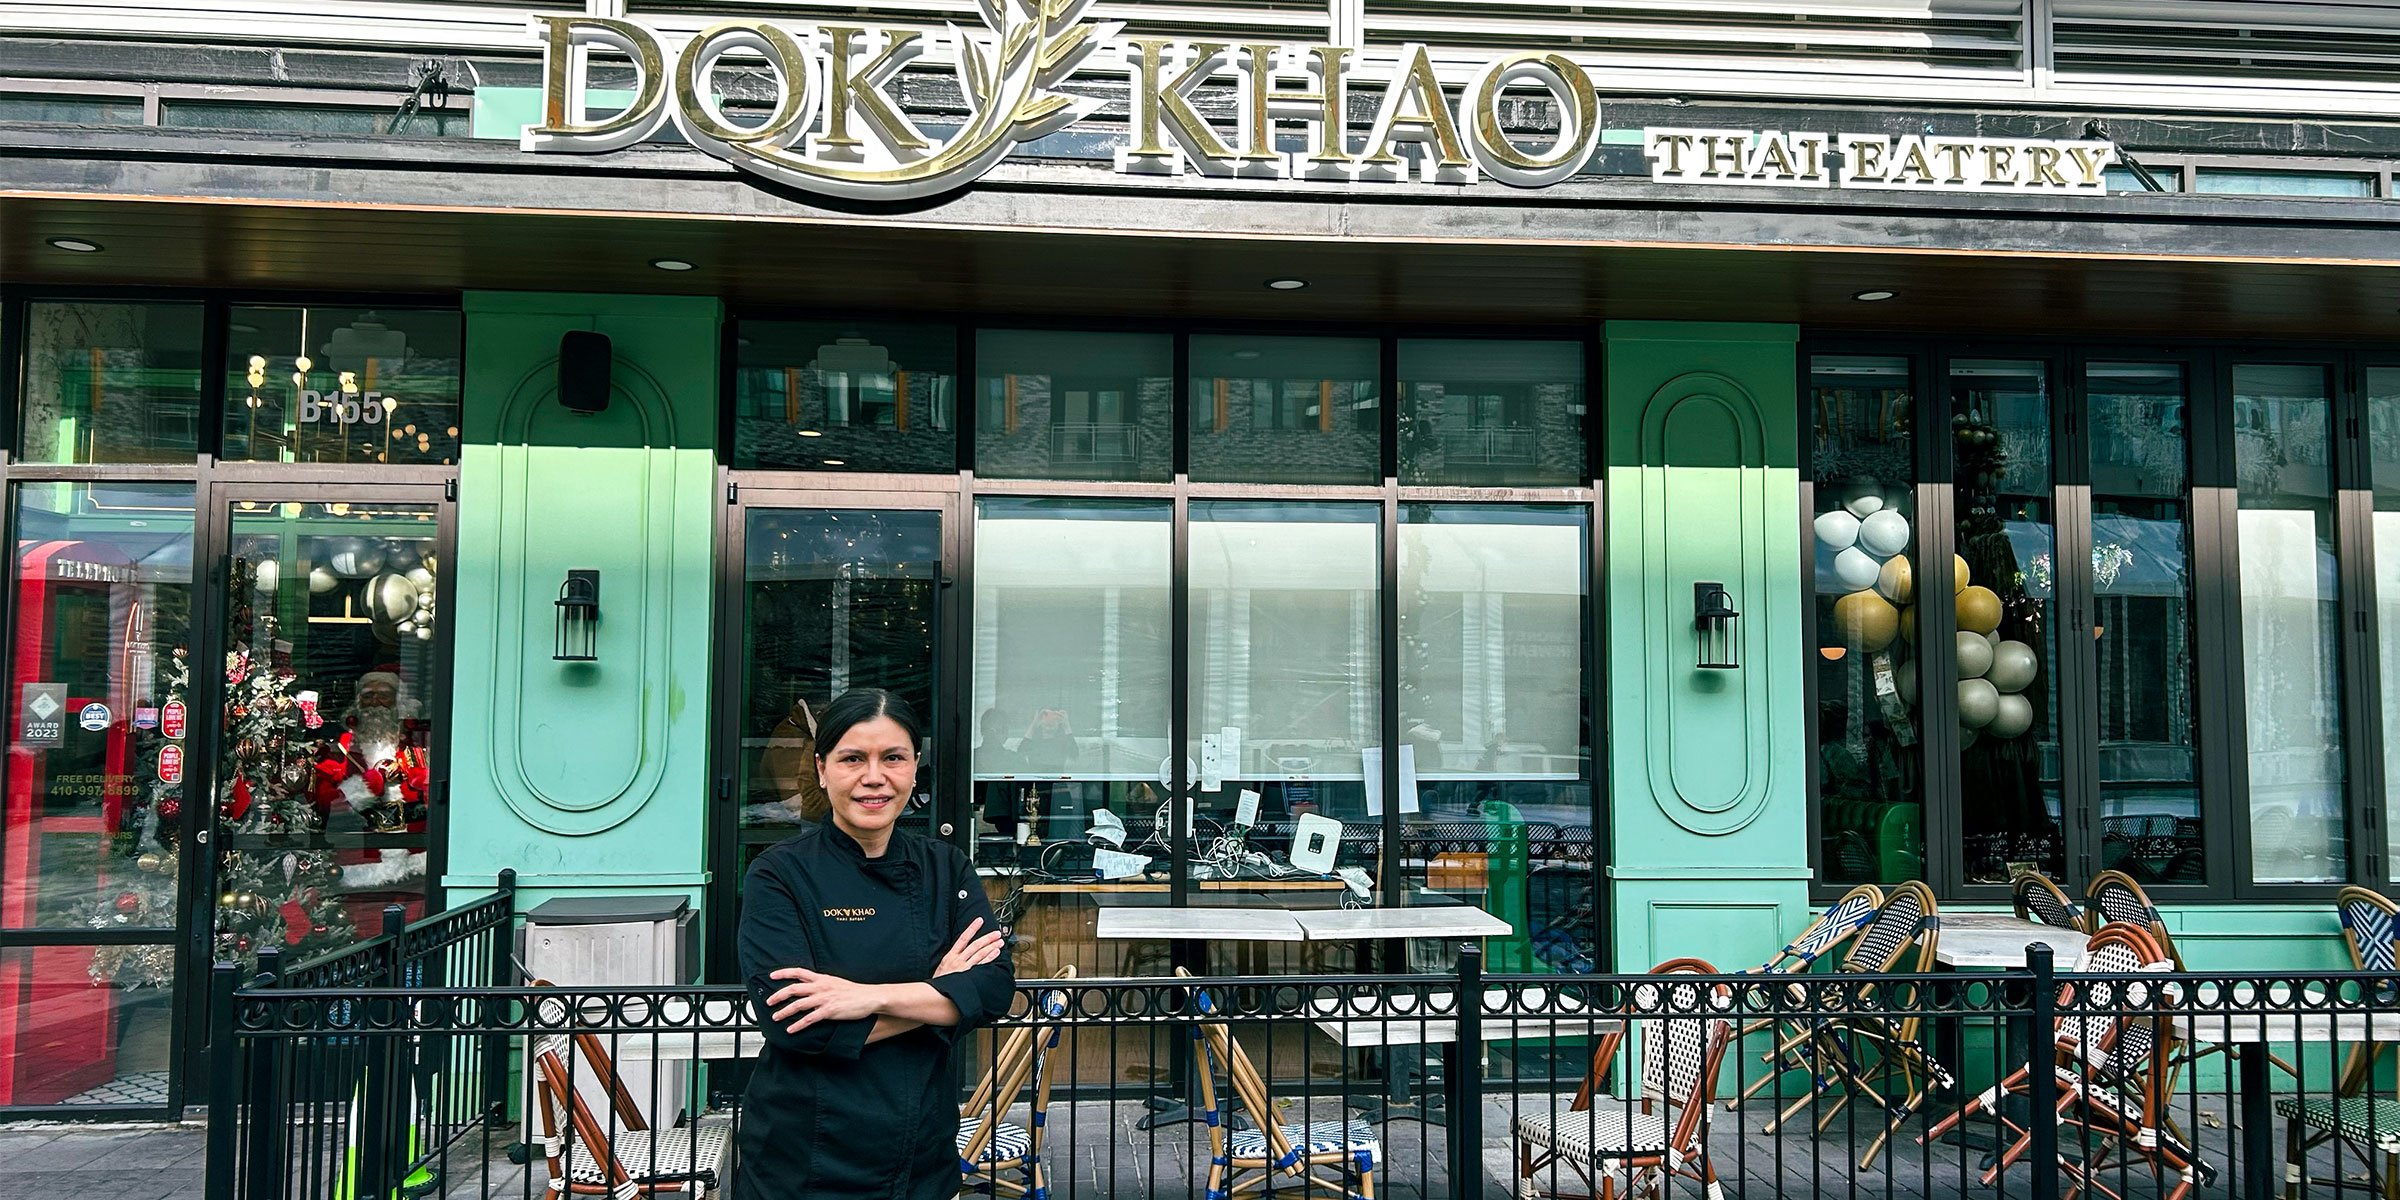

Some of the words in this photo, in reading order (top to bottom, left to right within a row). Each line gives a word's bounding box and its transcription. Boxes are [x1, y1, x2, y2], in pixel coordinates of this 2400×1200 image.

[521, 12, 935, 160] DOK
[1117, 40, 1602, 182] KHAO
[1653, 132, 1824, 179] THAI
[1848, 139, 2111, 190] EATERY
[300, 389, 383, 424] B155
[26, 729, 58, 738] 2023
[56, 774, 83, 784] FREE
[85, 774, 136, 784] DELIVERY
[823, 908, 844, 917] DOK
[851, 907, 876, 917] KHAO
